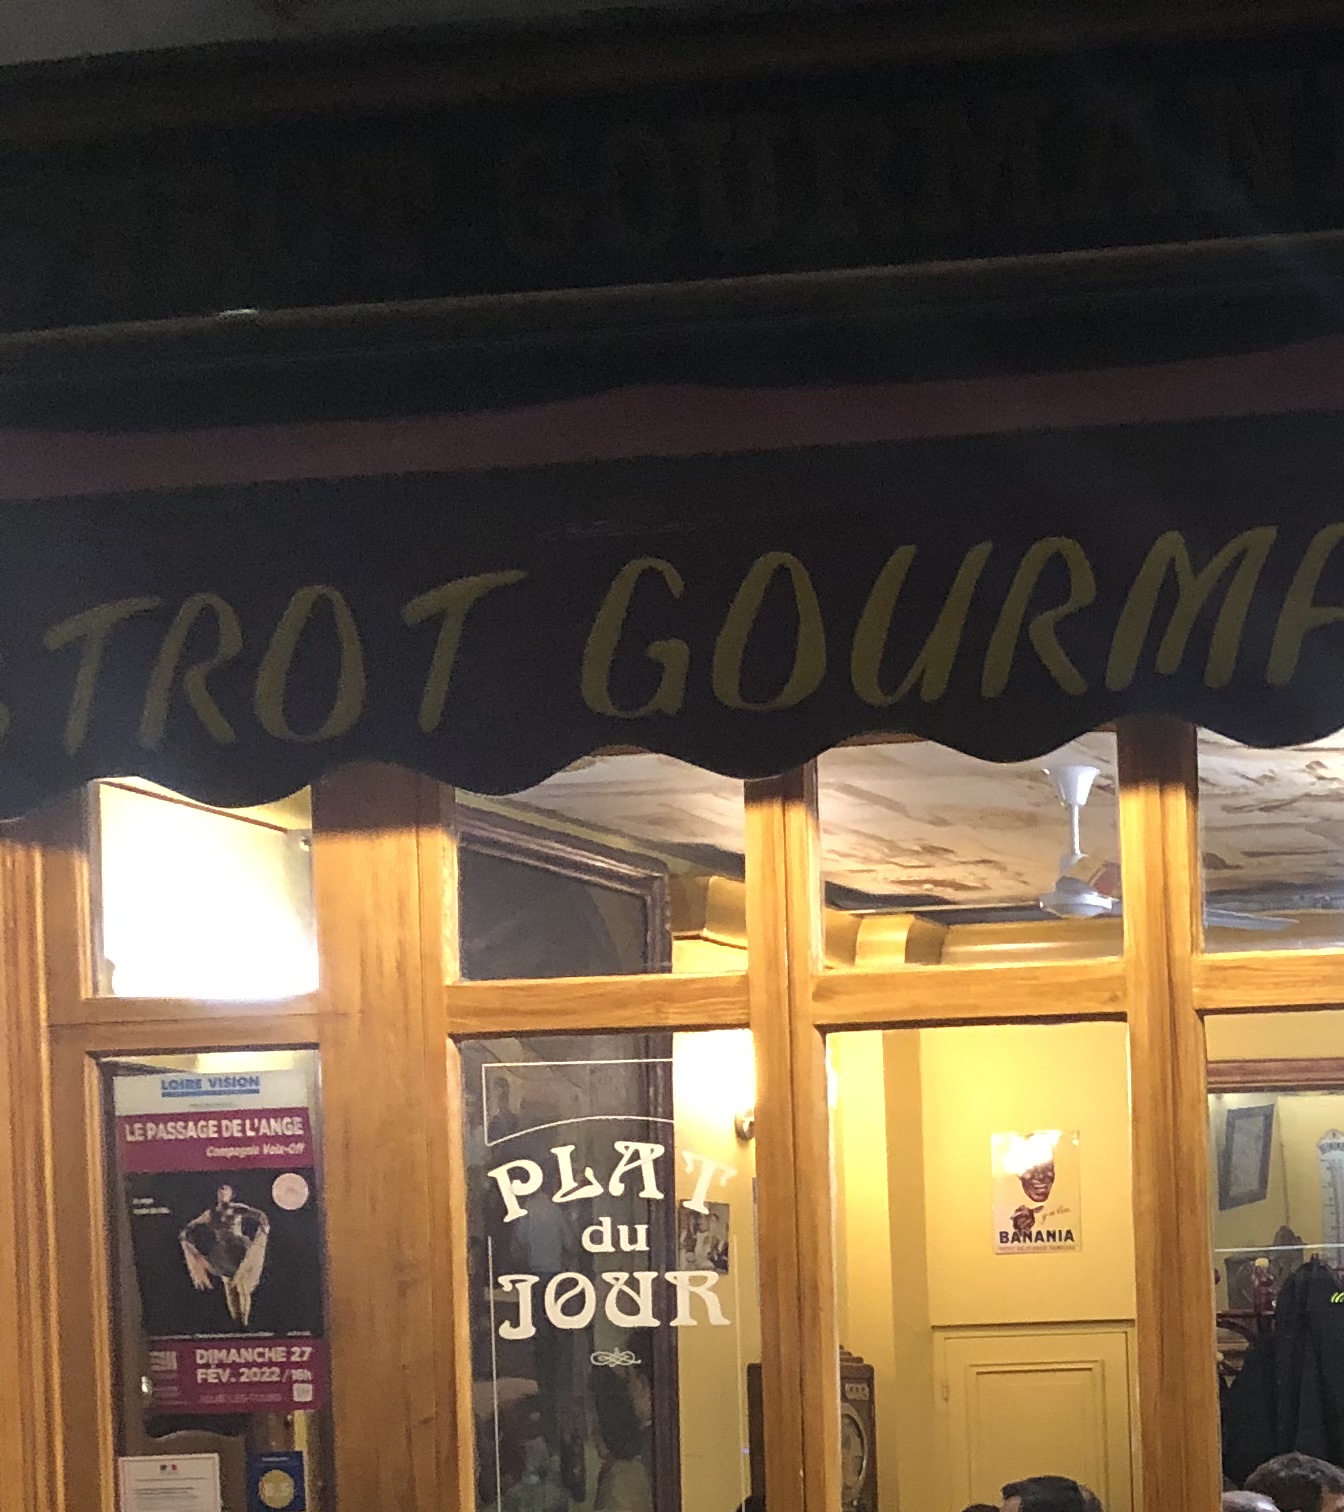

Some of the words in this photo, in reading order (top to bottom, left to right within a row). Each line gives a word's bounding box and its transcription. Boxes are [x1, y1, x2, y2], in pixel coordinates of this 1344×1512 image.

[0, 569, 527, 756] TROT
[161, 1078, 202, 1091] LOIRE
[208, 1076, 260, 1089] VISION
[125, 1122, 144, 1142] LE
[147, 1120, 218, 1141] PASSAGE
[222, 1118, 242, 1138] DE
[245, 1116, 304, 1136] L'ANGE
[487, 1140, 737, 1223] PLAT
[581, 1216, 650, 1253] du
[999, 1229, 1075, 1244] BANANIA
[497, 1270, 731, 1340] JOUR
[195, 1347, 287, 1364] DIMANCHE
[290, 1346, 312, 1362] 27
[196, 1365, 236, 1384] FÉV.
[239, 1367, 281, 1382] 2022
